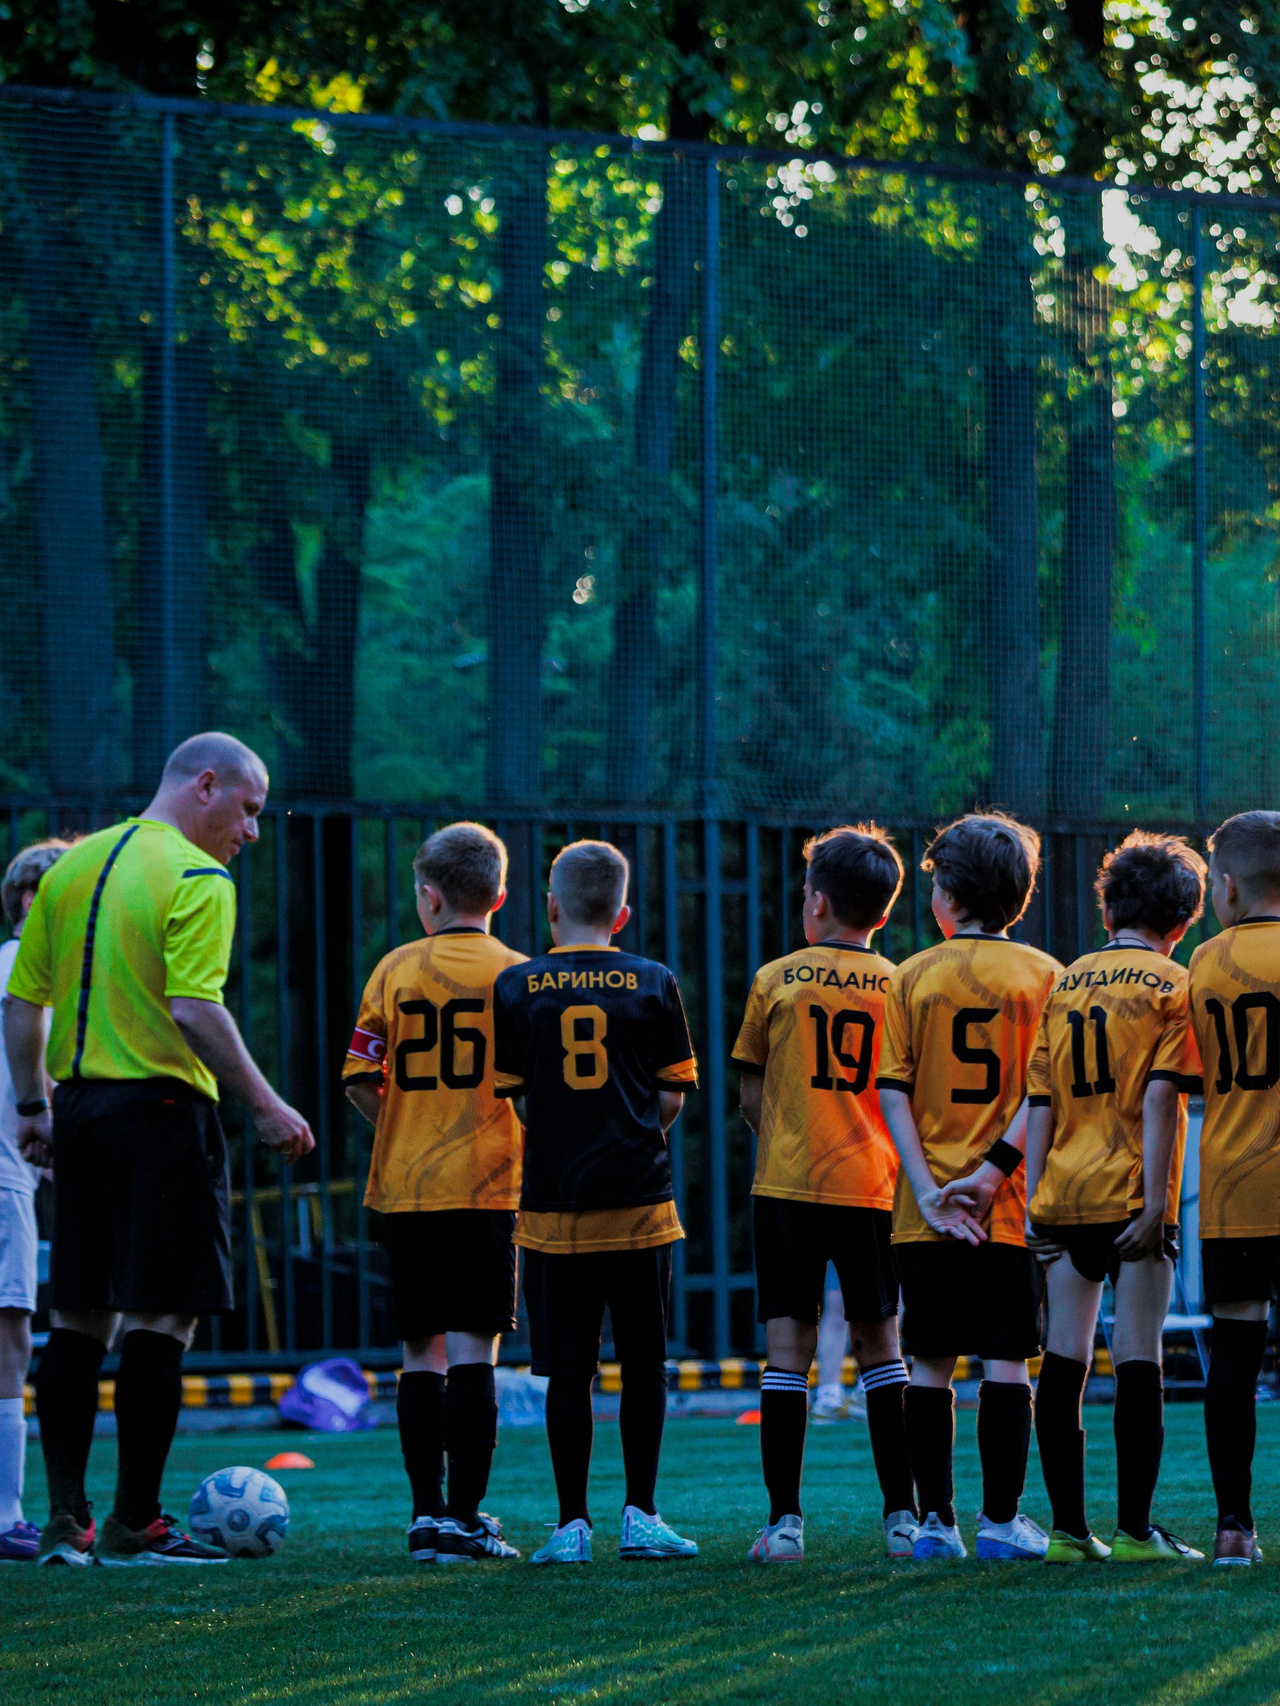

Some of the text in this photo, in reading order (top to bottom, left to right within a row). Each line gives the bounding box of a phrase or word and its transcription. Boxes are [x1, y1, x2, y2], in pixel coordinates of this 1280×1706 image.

[527, 970, 638, 994] БАРИНОВ
[784, 966, 890, 993] БОГДАНО
[1053, 967, 1174, 993] ЯУТДИНОВ
[395, 998, 486, 1092] 26
[560, 1005, 608, 1090] 8
[809, 1005, 875, 1095] 19
[951, 1008, 1001, 1104] 5
[1067, 1005, 1116, 1098] 11
